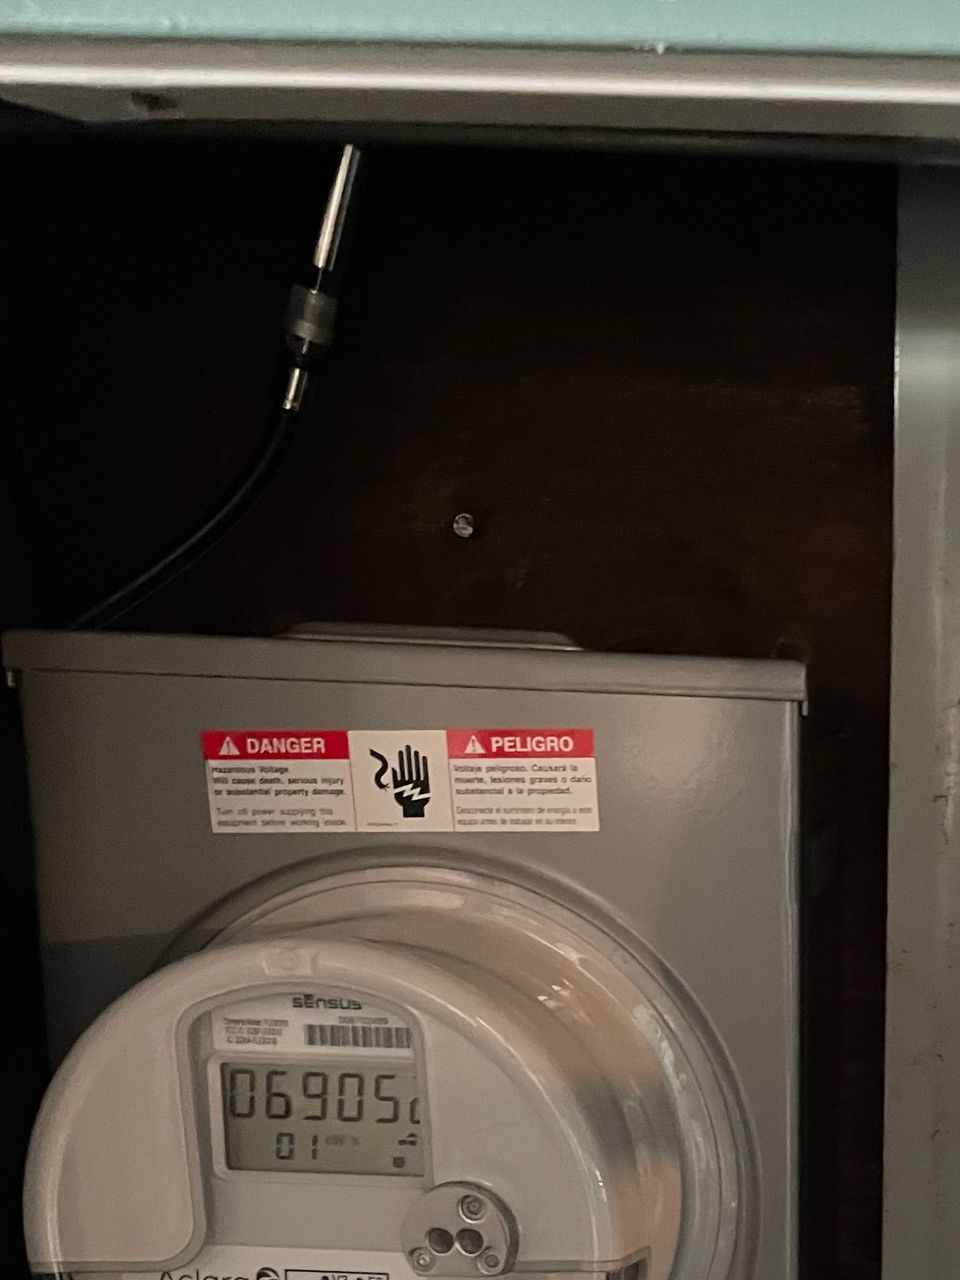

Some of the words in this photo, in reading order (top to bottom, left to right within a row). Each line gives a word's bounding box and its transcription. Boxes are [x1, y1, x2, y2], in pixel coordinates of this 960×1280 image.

[246, 738, 325, 754] DANGER
[491, 736, 574, 753] PELIGRO
[276, 1133, 318, 1160] 01
